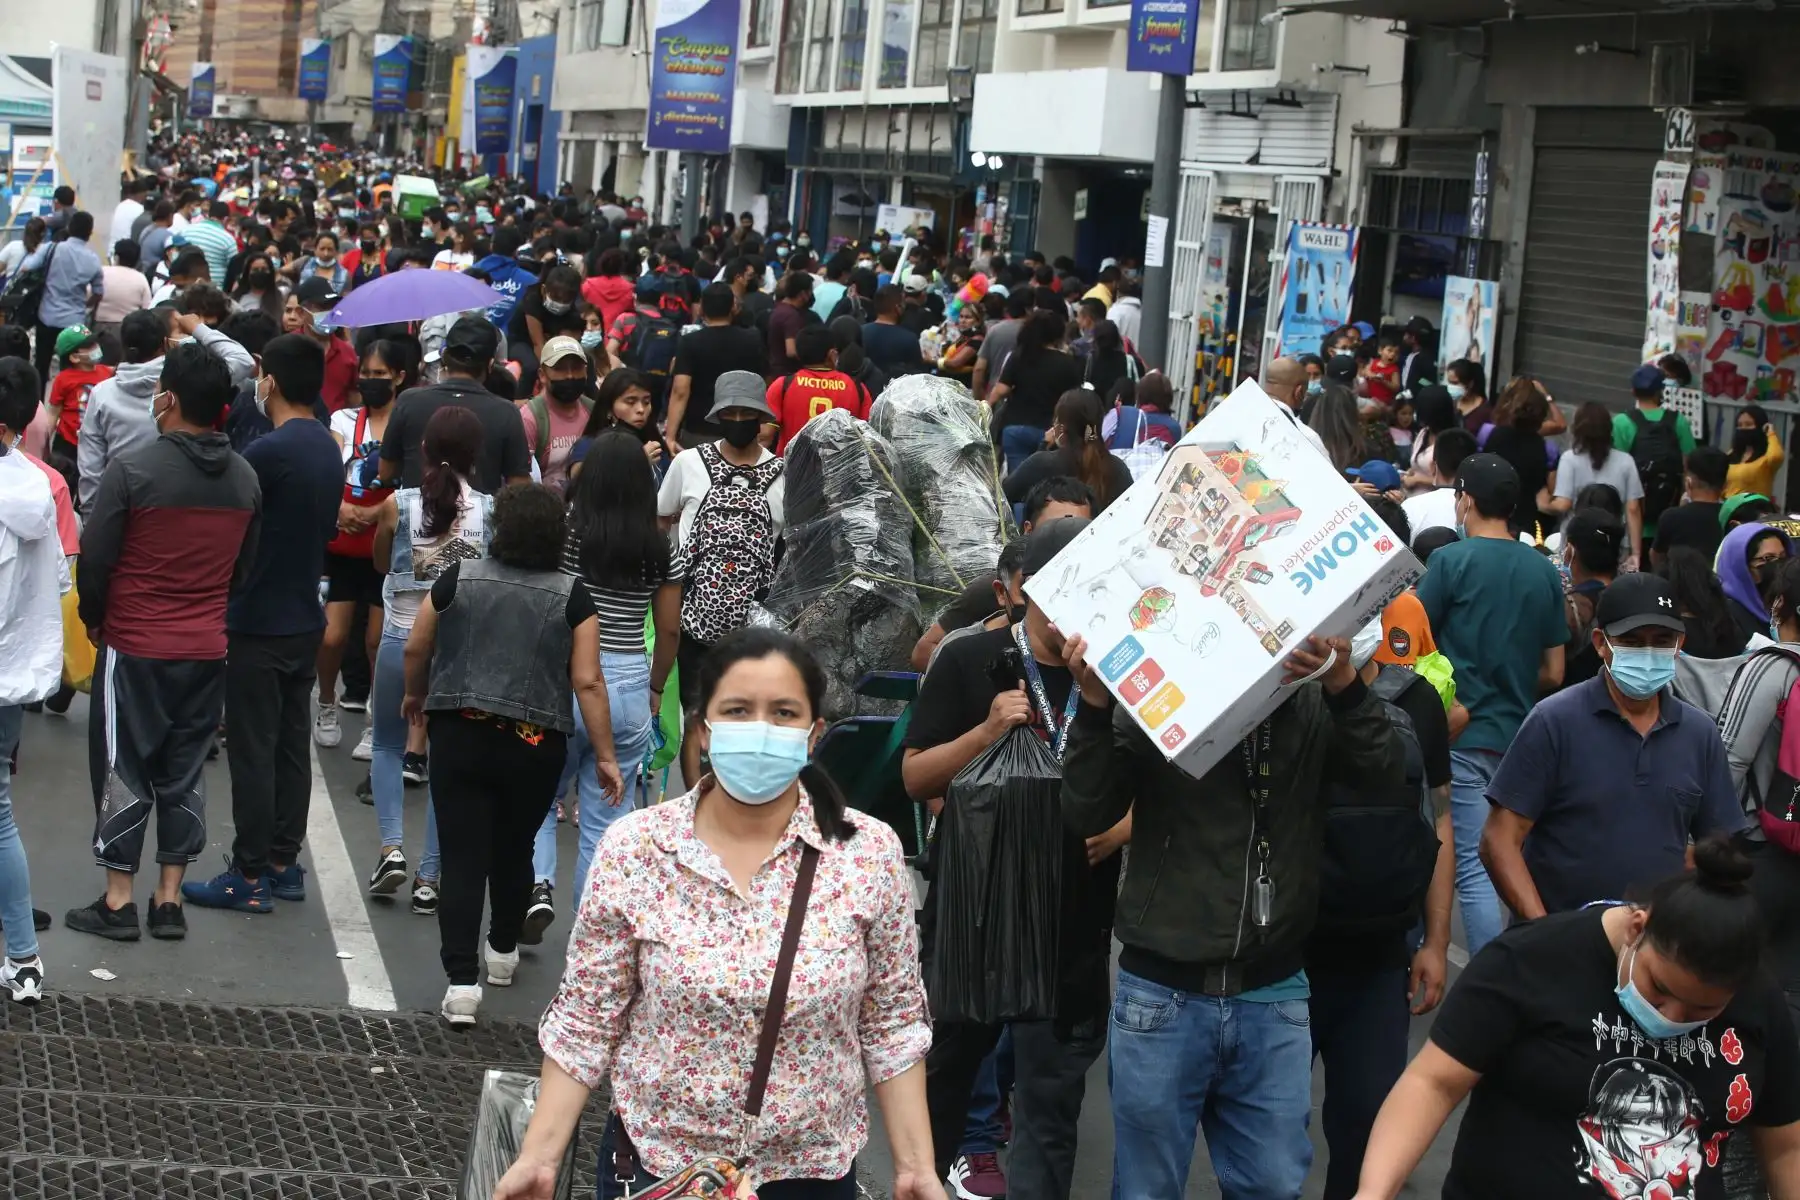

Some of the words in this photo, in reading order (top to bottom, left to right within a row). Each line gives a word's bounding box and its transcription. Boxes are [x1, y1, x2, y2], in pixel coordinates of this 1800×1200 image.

[1142, 16, 1181, 41] formal
[660, 36, 731, 62] Compra
[1304, 232, 1342, 247] WAHL
[796, 375, 847, 391] VICTORIO
[463, 529, 482, 538] Dior
[1278, 500, 1358, 574] supermarket
[1289, 511, 1379, 596] HOME
[1136, 677, 1150, 693] 48
